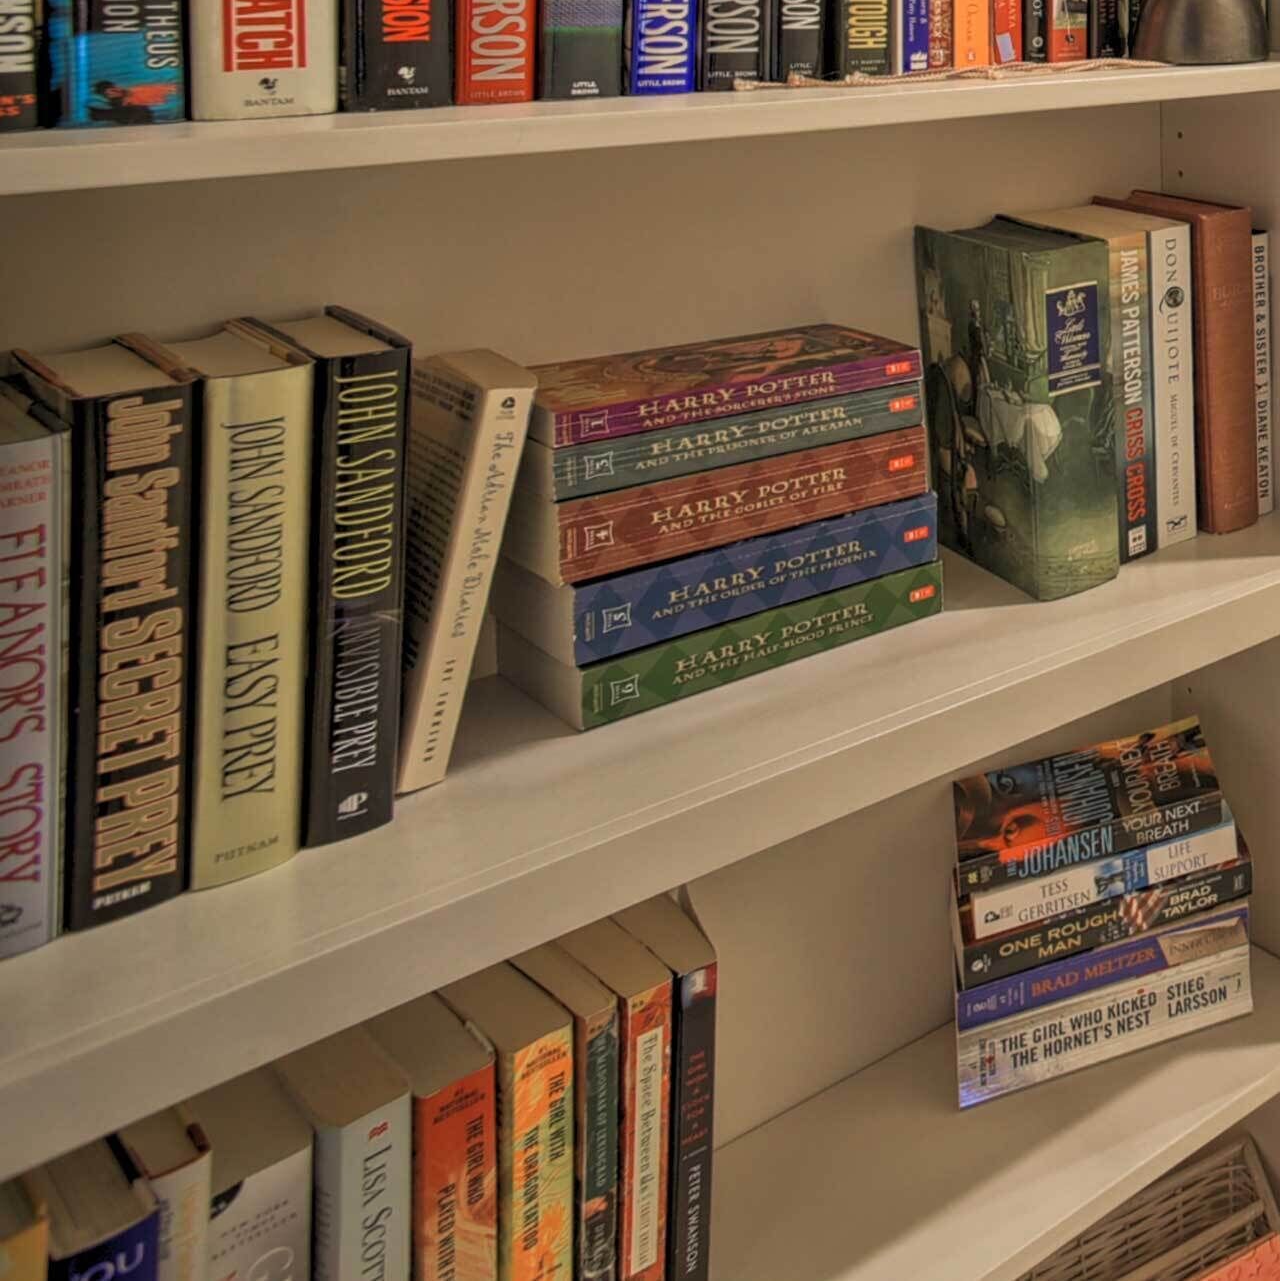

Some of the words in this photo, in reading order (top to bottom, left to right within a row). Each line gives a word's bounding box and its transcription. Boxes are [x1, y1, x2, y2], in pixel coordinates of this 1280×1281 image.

[244, 96, 295, 107] BANTAM
[1120, 249, 1139, 304] JAMES
[1165, 238, 1177, 283] DON
[1254, 245, 1265, 309] BROTHER
[1255, 313, 1265, 323] &
[1122, 307, 1141, 406] PATTERSON
[1255, 326, 1267, 376] SISTER
[639, 388, 736, 417] HARRY
[747, 371, 836, 397] POTTER
[1169, 394, 1177, 435] MIGUEL
[651, 425, 748, 454] HARRY
[758, 407, 846, 432] POTTER
[1123, 407, 1143, 459] CRISS
[1170, 439, 1177, 447] DE
[1258, 400, 1268, 442] DIANE
[222, 417, 285, 485] JOHN
[1259, 445, 1269, 497] KEATON
[651, 490, 749, 525] HARRY
[759, 468, 846, 497] POTTER
[1125, 462, 1146, 523] CROSS
[1170, 452, 1179, 507] CERVANTES
[658, 519, 692, 534] AND
[700, 510, 731, 524] THE
[737, 496, 785, 512] GOBLET
[813, 482, 843, 496] FIRE
[227, 484, 285, 614] SANDFORD
[668, 566, 764, 603] HARRY
[774, 540, 861, 573] POTTER
[675, 631, 772, 674] HARRY
[781, 603, 868, 638] POTTER
[224, 633, 280, 721] EASY
[222, 716, 278, 802] PREY
[1123, 810, 1161, 833] YOUR
[1165, 801, 1201, 819] NEXT
[1136, 819, 1190, 844] BREATH
[214, 835, 278, 863] PUTNAM
[1019, 826, 1114, 877] JOHANSEN
[1155, 854, 1208, 880] SUPPORT
[1168, 842, 1192, 859] LIFE
[1018, 890, 1091, 923] GERRITSEN
[1040, 880, 1068, 898] TESS
[1162, 894, 1218, 917] TAYLOR
[1170, 885, 1211, 905] BRAD
[1000, 935, 1042, 956] ONE
[1047, 911, 1120, 939] ROUGH
[1038, 936, 1082, 959] MAN
[1031, 972, 1079, 997] BRAD
[1084, 948, 1156, 980] MELTZER
[1167, 978, 1205, 1000] STIEG
[1001, 1029, 1028, 1052] THE
[1033, 1018, 1065, 1042] GIRL
[1070, 1009, 1102, 1033] WHO
[1107, 993, 1157, 1020] KICKED
[1168, 987, 1227, 1018] LARSSON
[643, 1033, 658, 1061] The
[1010, 1045, 1038, 1069] THE
[1043, 1021, 1112, 1061] HORNET'S
[1117, 1010, 1150, 1038] NEST
[548, 1071, 566, 1097] THE
[640, 1063, 657, 1106] Space
[549, 1097, 566, 1127] GIRL
[523, 1125, 539, 1151] THE
[549, 1129, 565, 1161] WITH
[640, 1106, 657, 1175] Between
[364, 1144, 391, 1206] LISA
[523, 1150, 539, 1206] DRAGON
[688, 1164, 700, 1202] PETER
[523, 1200, 539, 1252] TATTOO
[687, 1204, 700, 1273] SWANSON
